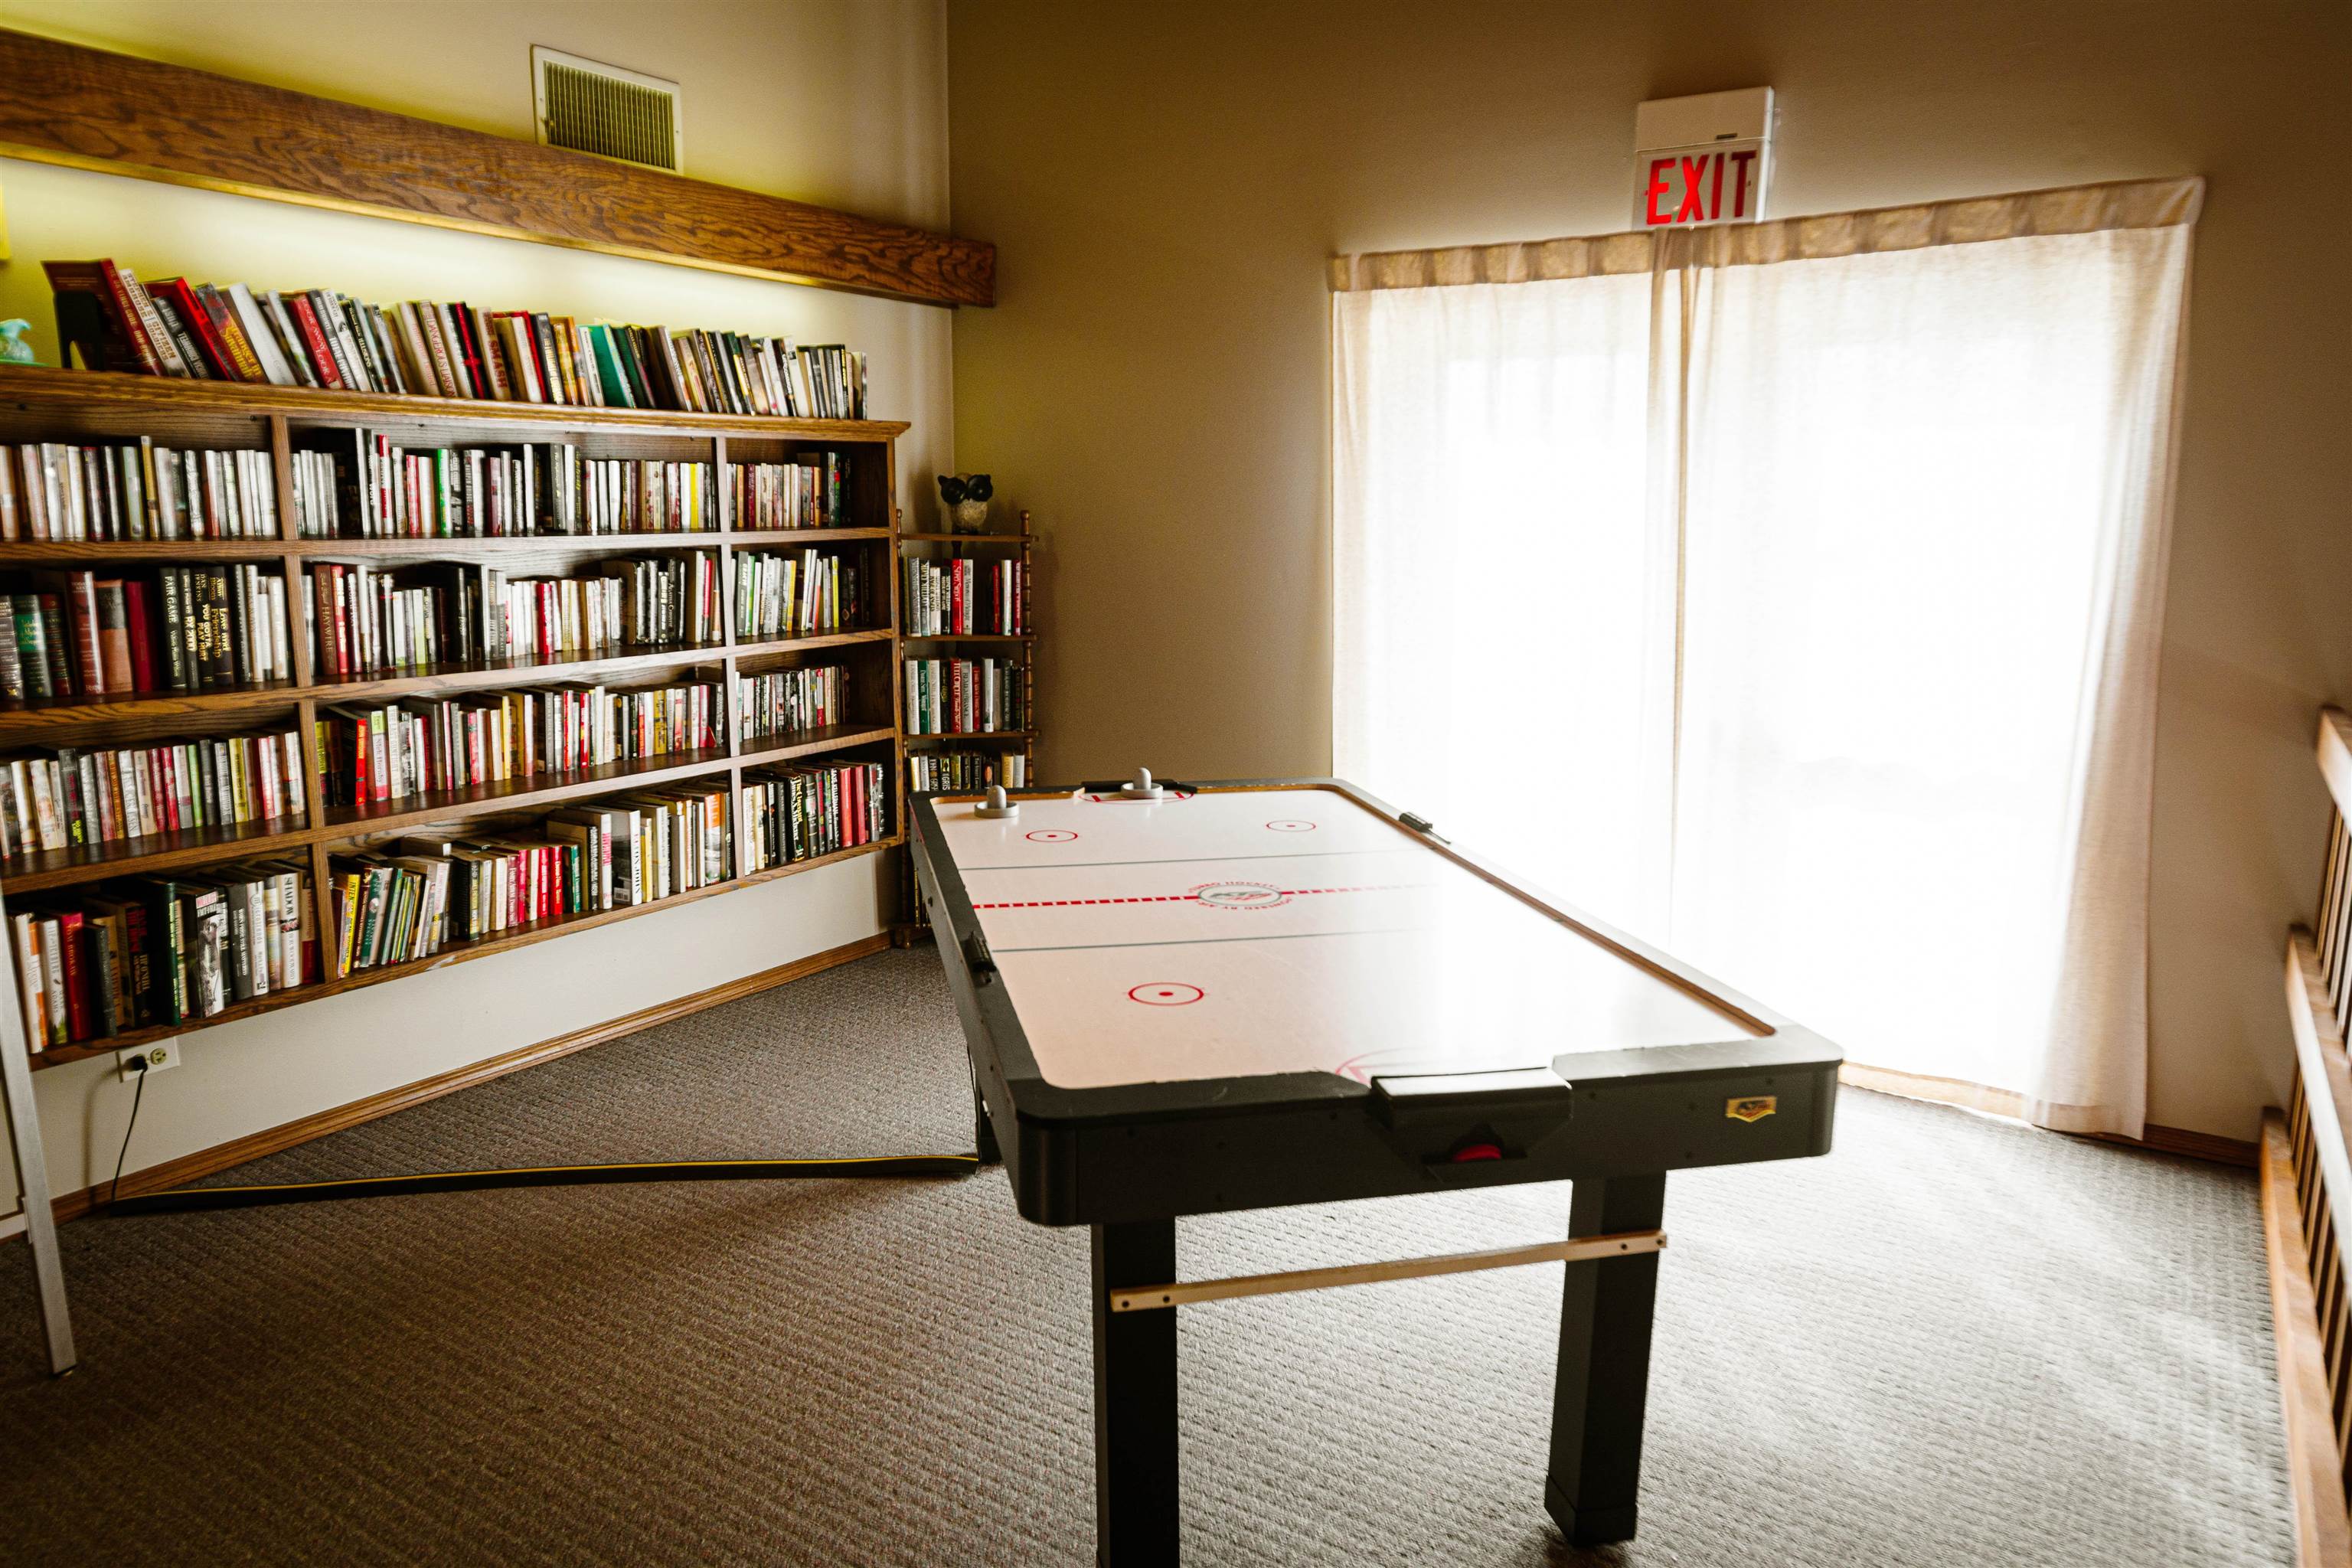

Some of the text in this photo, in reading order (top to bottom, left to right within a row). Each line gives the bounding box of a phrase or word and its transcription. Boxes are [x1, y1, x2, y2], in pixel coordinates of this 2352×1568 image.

[1646, 150, 1757, 225] EXIT
[121, 274, 147, 318] AMBROSE
[124, 309, 137, 326] CODE
[145, 323, 169, 361] SOLDIERS
[151, 319, 175, 359] CITIZEN
[328, 335, 343, 358] TOTAL
[426, 319, 446, 368] DANGEROUS
[488, 339, 508, 389] SMASH
[165, 576, 176, 596] FAIR
[168, 596, 178, 624] GAME
[185, 616, 194, 629] RX
[202, 604, 212, 648] YOU GOTTA
[322, 606, 334, 651] HAYWIRE
[185, 629, 196, 651] 2000
[211, 608, 221, 658] Friendship
[219, 607, 230, 651] Love and
[198, 642, 208, 662] HURT
[375, 756, 384, 784] Hornby
[792, 777, 802, 794] The
[285, 877, 294, 916] SHADOW
[50, 946, 60, 974] ICEBERG
[67, 944, 77, 976] BROKAW
[139, 954, 150, 991] TIP O'NEILL
